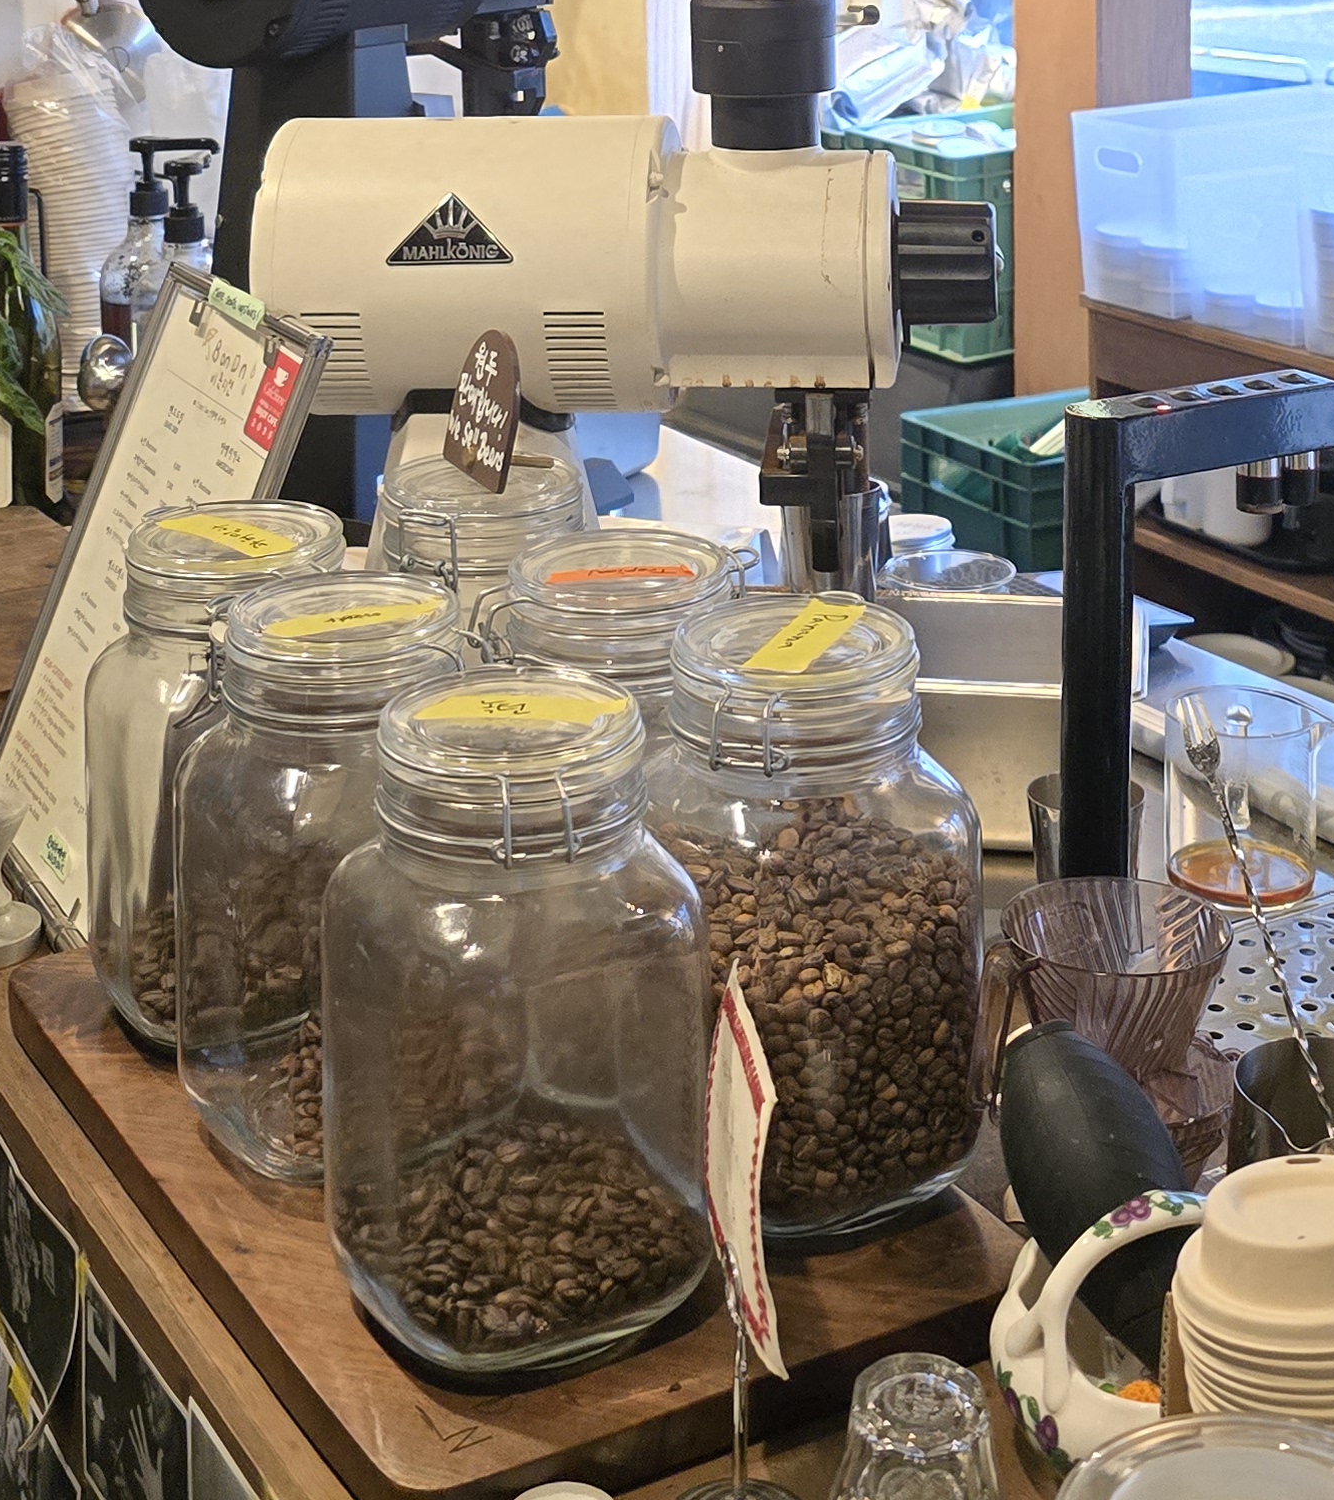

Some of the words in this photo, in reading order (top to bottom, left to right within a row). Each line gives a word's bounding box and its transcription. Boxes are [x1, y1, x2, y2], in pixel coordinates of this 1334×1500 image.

[401, 241, 500, 263] MAHLKÖNIG
[474, 341, 498, 387] 원두
[448, 409, 461, 441] We
